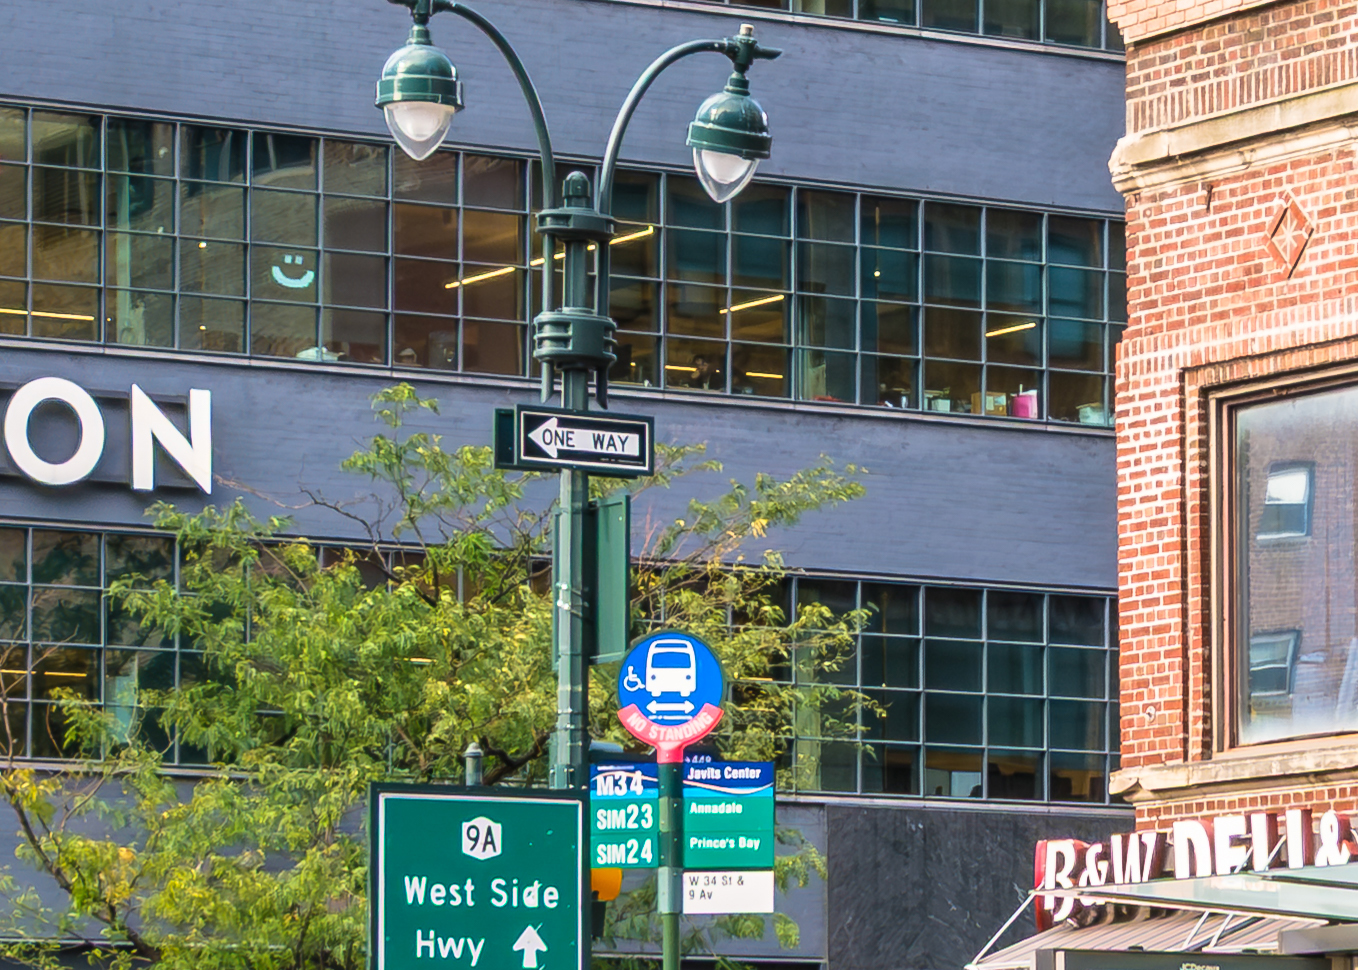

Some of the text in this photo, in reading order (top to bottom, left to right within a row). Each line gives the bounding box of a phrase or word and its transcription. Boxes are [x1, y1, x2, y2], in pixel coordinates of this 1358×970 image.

[542, 428, 629, 452] ONE WAY
[626, 711, 714, 742] NO STANDING
[596, 770, 644, 796] M34
[687, 766, 762, 781] Javits Center
[596, 804, 654, 831] SIM23
[689, 802, 743, 815] Annadale
[464, 823, 498, 854] 9A
[689, 837, 761, 851] Prince's Bay
[596, 839, 653, 865] SIM24
[689, 875, 745, 886] W 34 St &
[1045, 832, 1158, 915] B&W
[405, 875, 560, 909] West Side
[689, 889, 714, 900] 9 Av
[416, 929, 486, 968] Hwy
